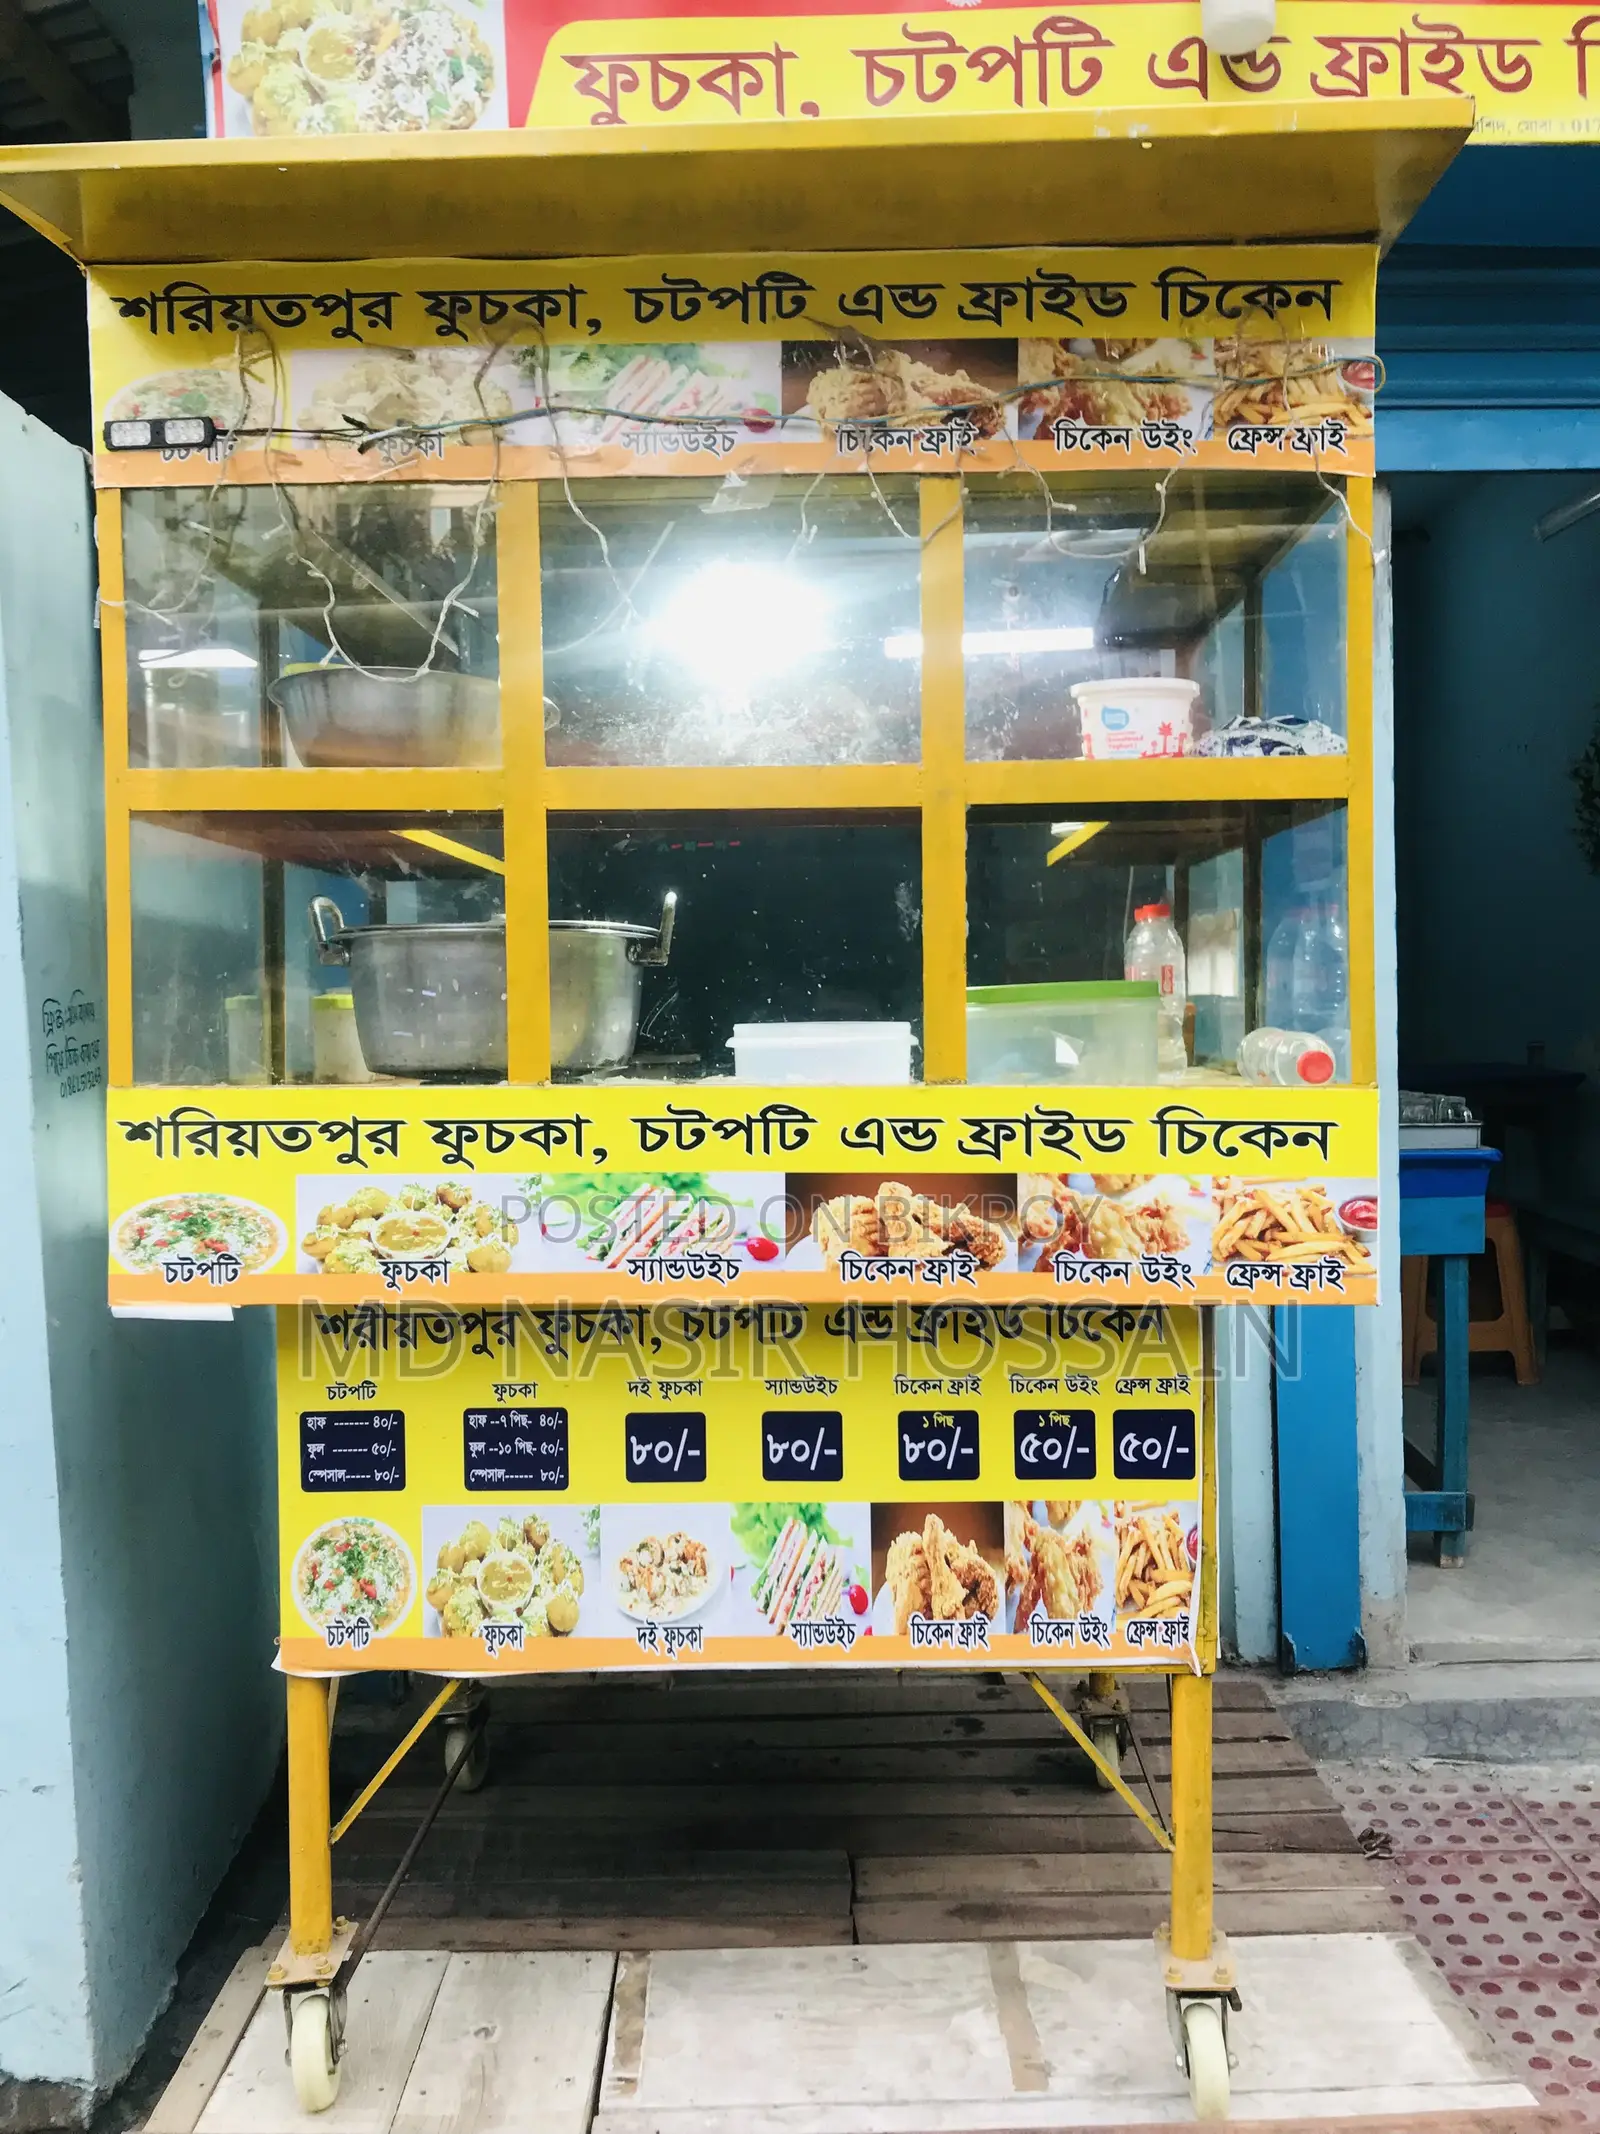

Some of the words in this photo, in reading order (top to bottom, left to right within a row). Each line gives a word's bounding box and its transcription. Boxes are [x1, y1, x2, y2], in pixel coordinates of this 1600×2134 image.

[561, 40, 820, 125] ফুচকা,
[849, 15, 1116, 108] চটপটি
[1310, 13, 1542, 98] ফ্রাইড
[113, 280, 401, 338] শরিয়তপুর
[416, 283, 602, 338] ফুচকা,
[625, 272, 817, 324] চটপটি
[839, 281, 945, 325] এন্ড
[957, 267, 1137, 328] ফ্রাইড
[1152, 266, 1344, 325] চিকেন
[620, 422, 738, 457] স্যান্ডউইচ
[1053, 418, 1133, 452] চিকেন
[1140, 419, 1197, 453] উইং
[1291, 420, 1347, 454] ফ্রাই
[117, 1105, 408, 1166] শরিয়তপুর
[424, 1113, 609, 1169] ফুচকা,
[631, 1103, 818, 1158] চটপটি
[839, 1116, 943, 1156] এন্ড
[957, 1105, 1134, 1162] ফ্রাইড
[1152, 1105, 1342, 1162] চিকেন
[163, 1256, 241, 1286] চটপটি
[378, 1258, 451, 1292] ফুচকা
[627, 1254, 743, 1285] স্যান্ডউইচ
[839, 1254, 916, 1285] চিকেন
[921, 1253, 979, 1288] ফ্রাই
[1053, 1253, 1131, 1286] চিকেন
[1140, 1254, 1197, 1290] উইং
[1226, 1263, 1284, 1291] ফ্রেন্স
[1292, 1257, 1347, 1292] ফ্রাই
[315, 1303, 521, 1359] শরীয়তপুর
[533, 1304, 662, 1360] ফুচকা,
[825, 1303, 898, 1343] এন্ড
[326, 1380, 377, 1401] চটপটি
[492, 1381, 538, 1404] ফুচকা
[627, 1377, 652, 1399] দই
[657, 1379, 703, 1402] ফুচকা
[765, 1375, 839, 1397] স্যান্ডউইচ
[894, 1375, 942, 1395] চিকেন
[947, 1375, 983, 1397] ফ্রাই
[1009, 1374, 1059, 1395] চিকেন
[1065, 1374, 1100, 1395] উইং
[1115, 1378, 1151, 1396] ফ্রেন্স
[1156, 1374, 1191, 1396] ফ্রাই
[306, 1416, 327, 1431] হাফ
[373, 1413, 398, 1431] ৪০/-
[468, 1414, 487, 1429] হাফ
[539, 1412, 563, 1430] ৪০/-
[934, 1412, 954, 1428] পিছ
[1050, 1411, 1071, 1428] পিছ
[307, 1443, 325, 1460] ফুল
[371, 1440, 396, 1457] ৫০/-
[468, 1442, 486, 1458] ফুল
[540, 1439, 564, 1457] ৫০/-
[631, 1428, 701, 1472] ৮০/-
[767, 1426, 838, 1470] ৮০/-
[903, 1426, 974, 1470] ৮০/-
[1020, 1425, 1090, 1469] ৫০/-
[1119, 1425, 1189, 1469] ৫০/-
[374, 1466, 400, 1483] ৮০/-
[540, 1466, 564, 1484] ৮০/-
[326, 1618, 371, 1648] চটপটি
[484, 1624, 524, 1654] ফুচকা
[636, 1619, 658, 1650] দই
[663, 1624, 704, 1657] ফুচকা
[791, 1617, 856, 1647] স্যান্ডউইচ
[910, 1616, 953, 1646] চিকেন
[957, 1616, 991, 1649] ফ্রাই
[1030, 1615, 1074, 1646] চিকেন
[1078, 1615, 1111, 1648] উইং
[1127, 1621, 1158, 1647] ফ্রেন্স
[1162, 1613, 1189, 1647] ফ্রাই
